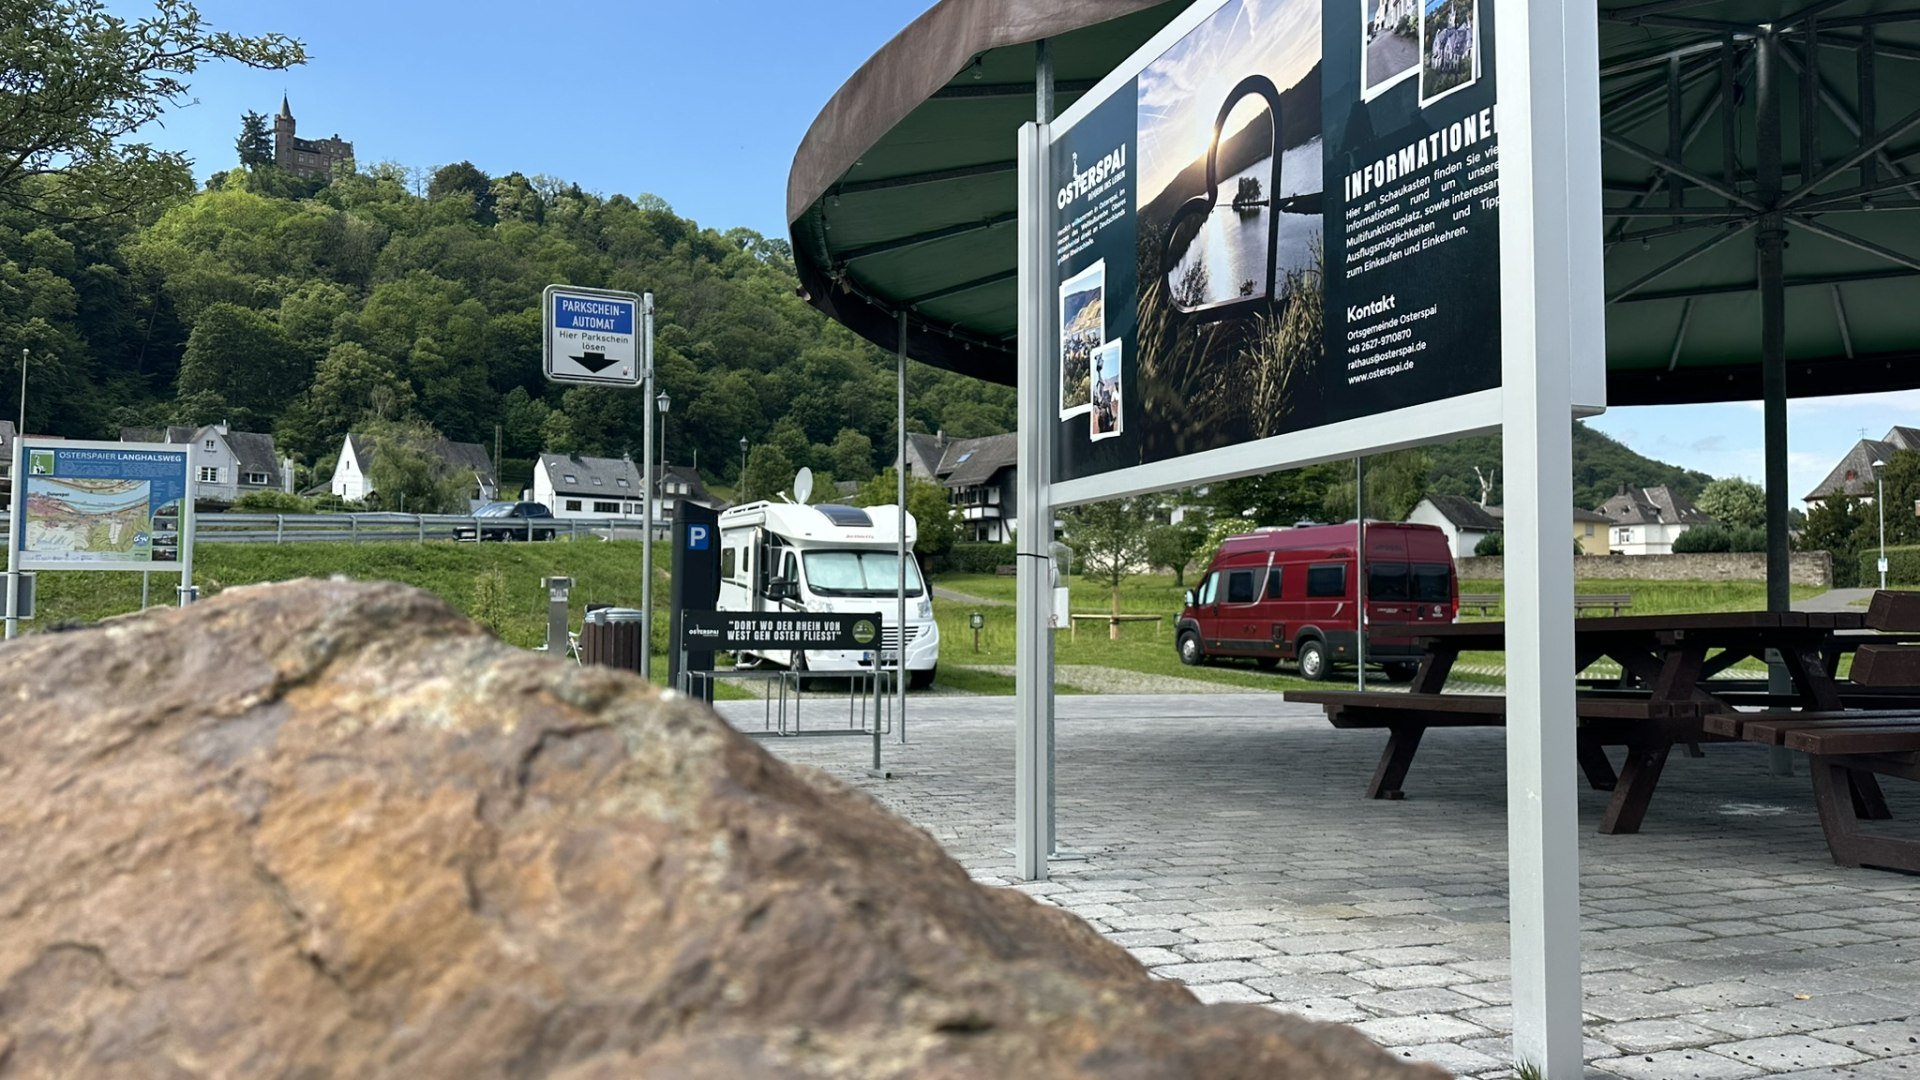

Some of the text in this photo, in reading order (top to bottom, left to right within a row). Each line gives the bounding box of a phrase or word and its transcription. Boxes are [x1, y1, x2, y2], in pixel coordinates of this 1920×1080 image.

[1057, 142, 1126, 210] OSTERSPAI
[1346, 206, 1361, 220] Hier
[1364, 201, 1377, 213] am
[1379, 175, 1430, 205] Schaukasten
[1434, 161, 1462, 181] finden
[1466, 153, 1481, 167] Sie
[1346, 203, 1400, 233] Informationen
[1410, 189, 1430, 206] rund
[1441, 179, 1456, 192] um
[1346, 210, 1423, 248] Multifunktionsplatz,
[1425, 197, 1450, 216] sowie
[1346, 220, 1435, 264] Ausflugsmöglichkeiten
[1452, 204, 1471, 221] und
[1346, 225, 1469, 279] zum Einkaufen und Einkehren.
[562, 300, 625, 316] PARKSCHEIN-
[1347, 294, 1395, 323] Kontakt
[572, 316, 615, 330] AUTOMAT
[1347, 303, 1437, 341] Ortsgemeinde Osterspai
[559, 330, 629, 344] Hier Parkschein
[582, 342, 606, 352] lösen
[1361, 328, 1412, 352] 2627-9710870
[1348, 340, 1427, 370] rathaus@osterspai.de
[1348, 360, 1414, 384] www.osterspai.de
[59, 451, 182, 462] OSTERSPAIER LANGHALSWEG
[690, 526, 706, 547] P
[727, 630, 751, 641] WEST
[754, 630, 771, 641] GEN
[773, 631, 801, 641] OSTEN
[759, 620, 774, 631] WO
[776, 620, 793, 631] DER
[796, 621, 821, 631] RHEIN
[824, 621, 841, 631] VON
